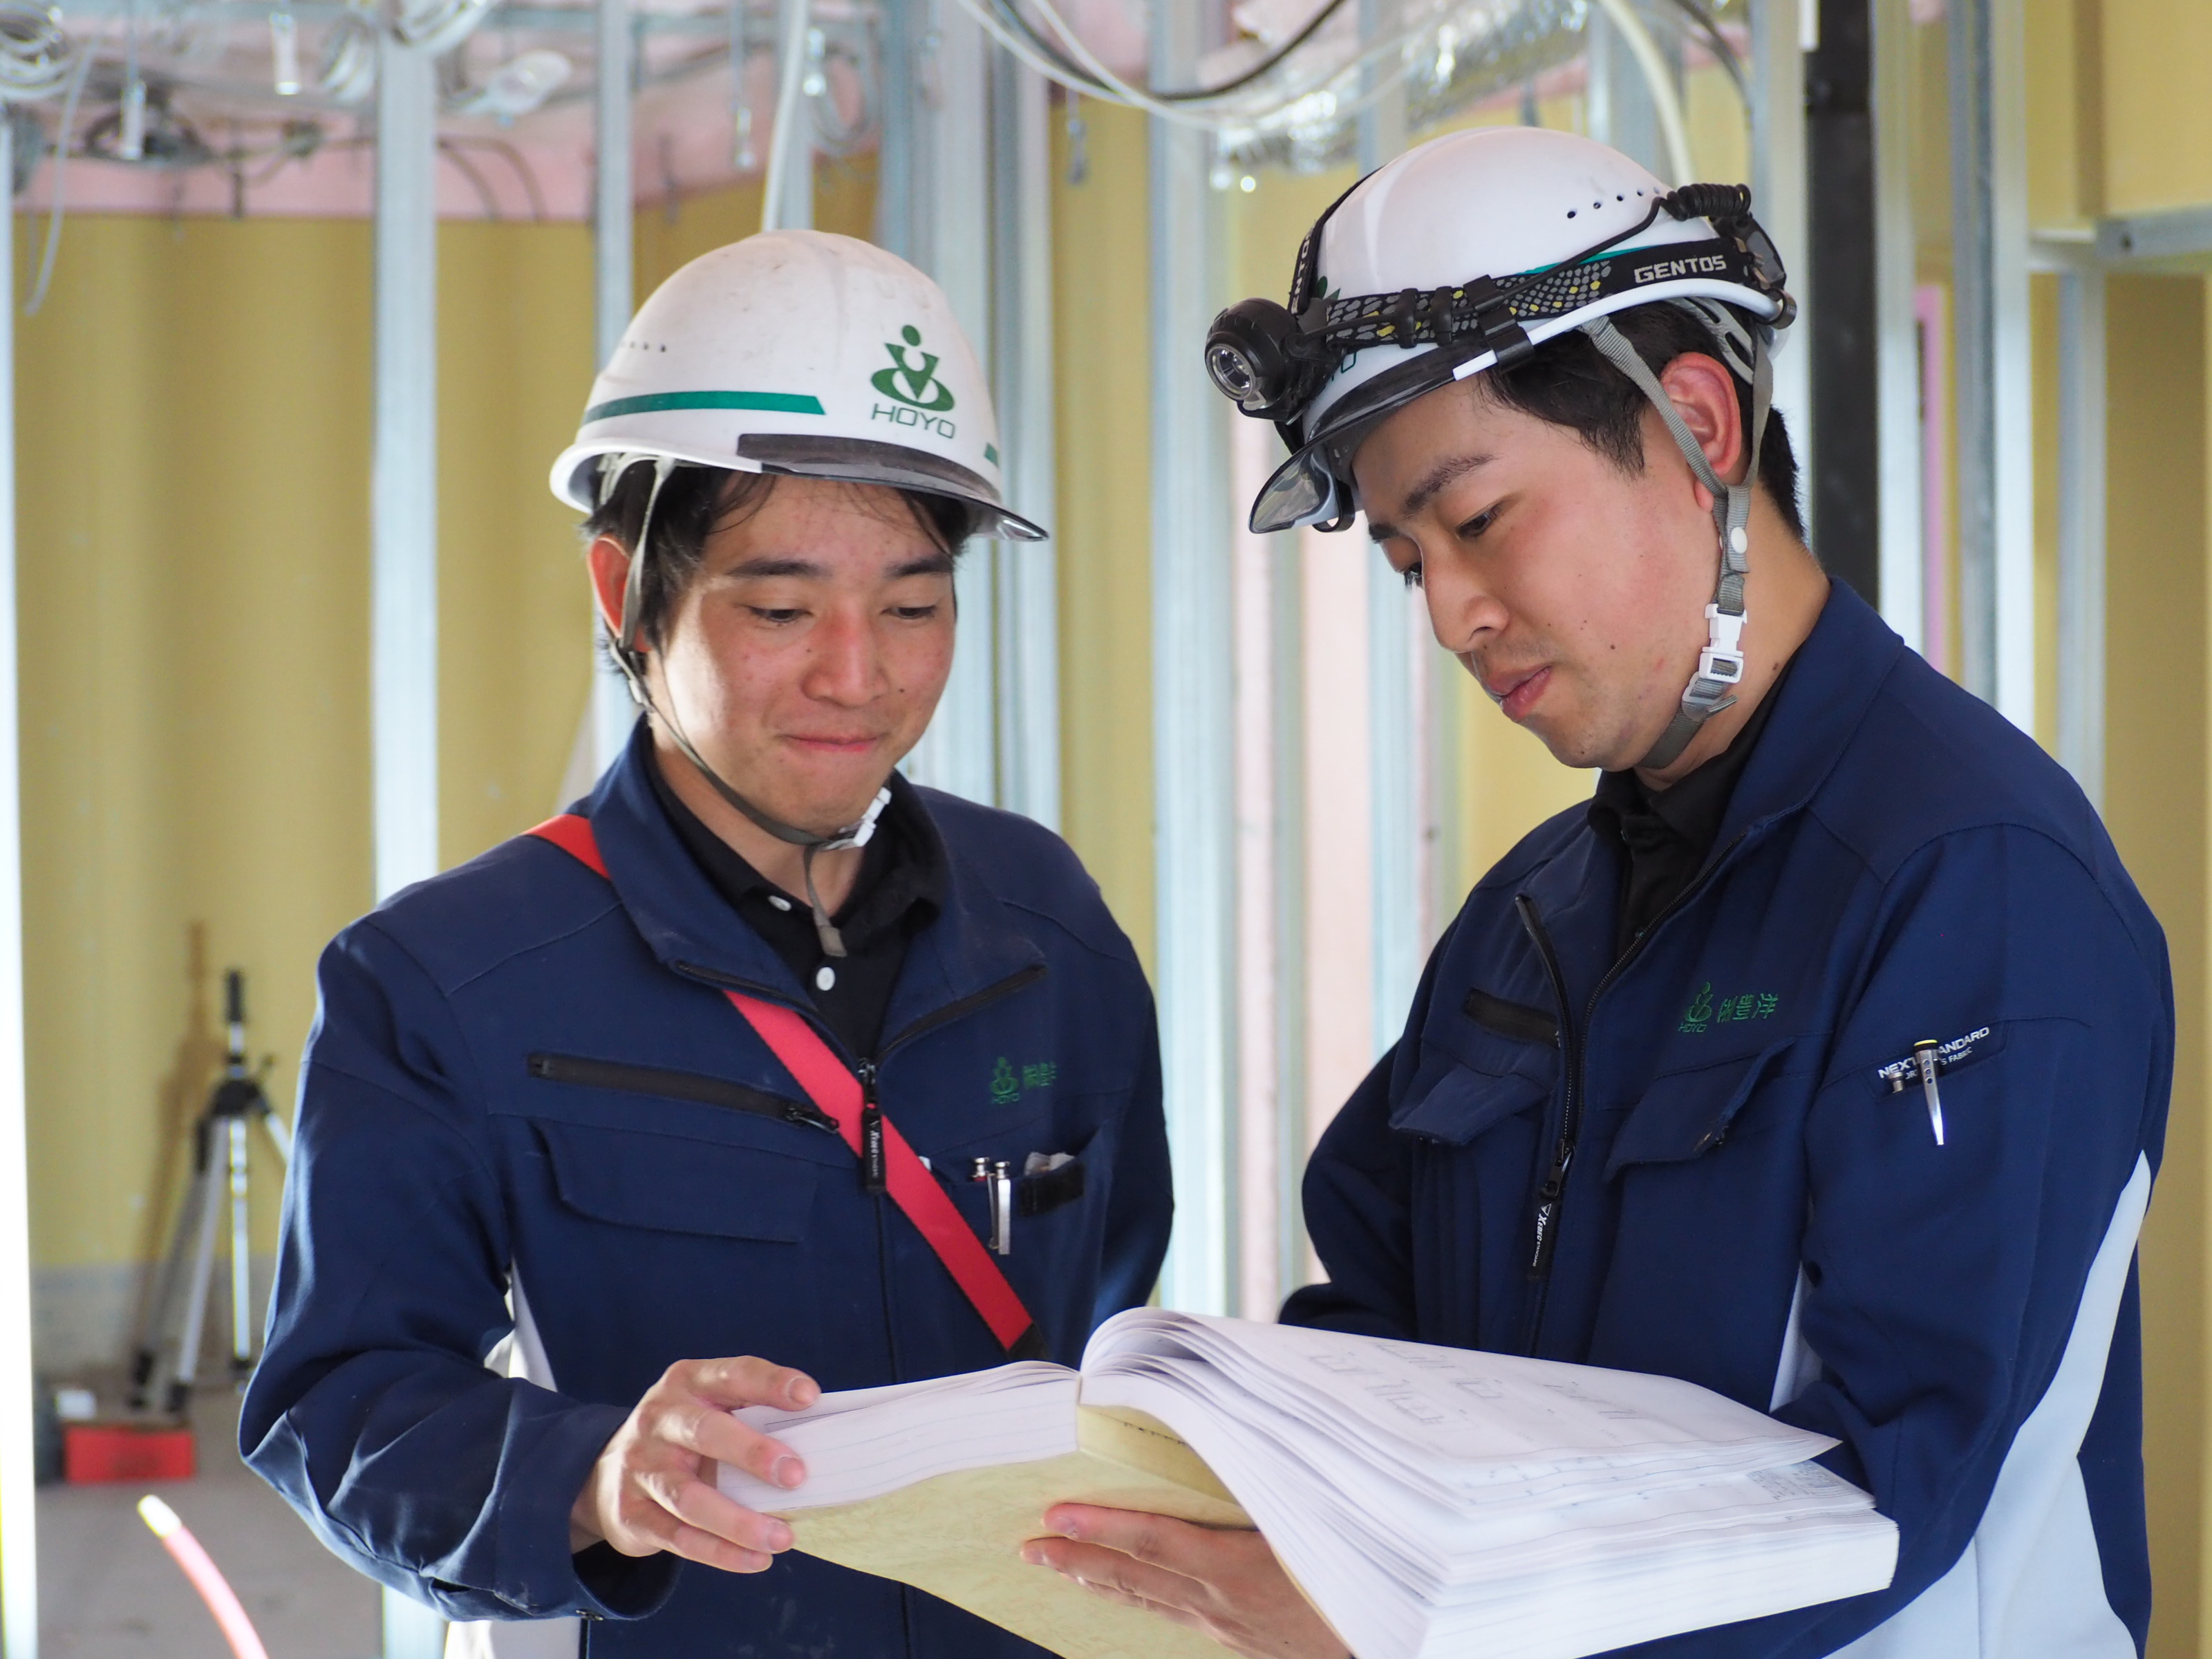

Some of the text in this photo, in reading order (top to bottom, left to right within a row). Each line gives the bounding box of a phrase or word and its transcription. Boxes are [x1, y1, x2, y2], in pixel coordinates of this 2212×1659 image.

[1633, 255, 1727, 283] GENTOS
[871, 403, 955, 439] HOYO
[1678, 1022, 1707, 1033] HOYO
[1877, 1056, 1917, 1078] NEXT
[1938, 1027, 1989, 1054] ANDARD
[1949, 1047, 1973, 1063] FABRIC
